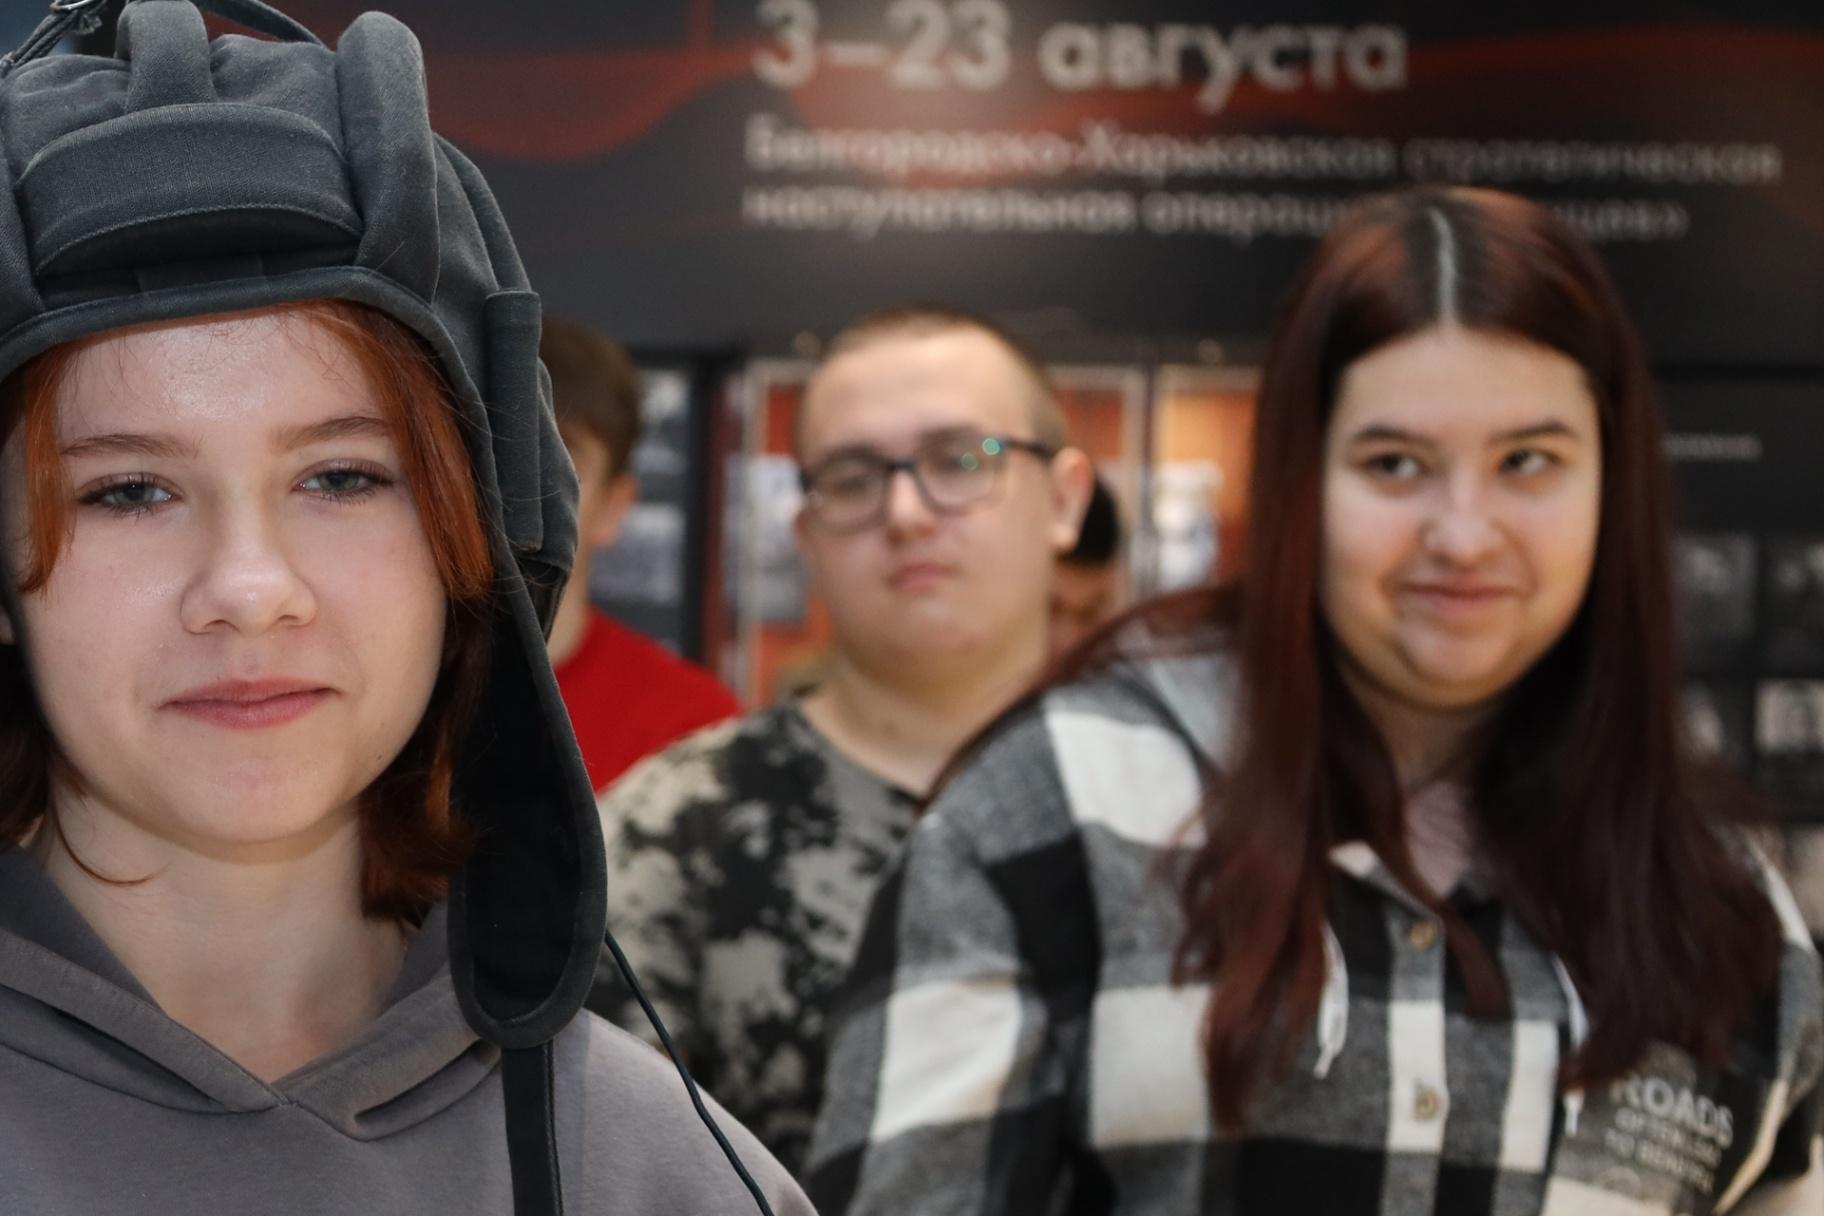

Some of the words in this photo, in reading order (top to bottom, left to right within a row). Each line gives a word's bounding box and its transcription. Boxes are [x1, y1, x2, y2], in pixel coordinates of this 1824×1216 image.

[1036, 21, 1409, 112] августа
[744, 114, 1397, 188] Белгородско-Харьковская
[1402, 138, 1782, 185] стратегическая
[743, 187, 1136, 240] наступательная
[1610, 1073, 1733, 1148] ROADS
